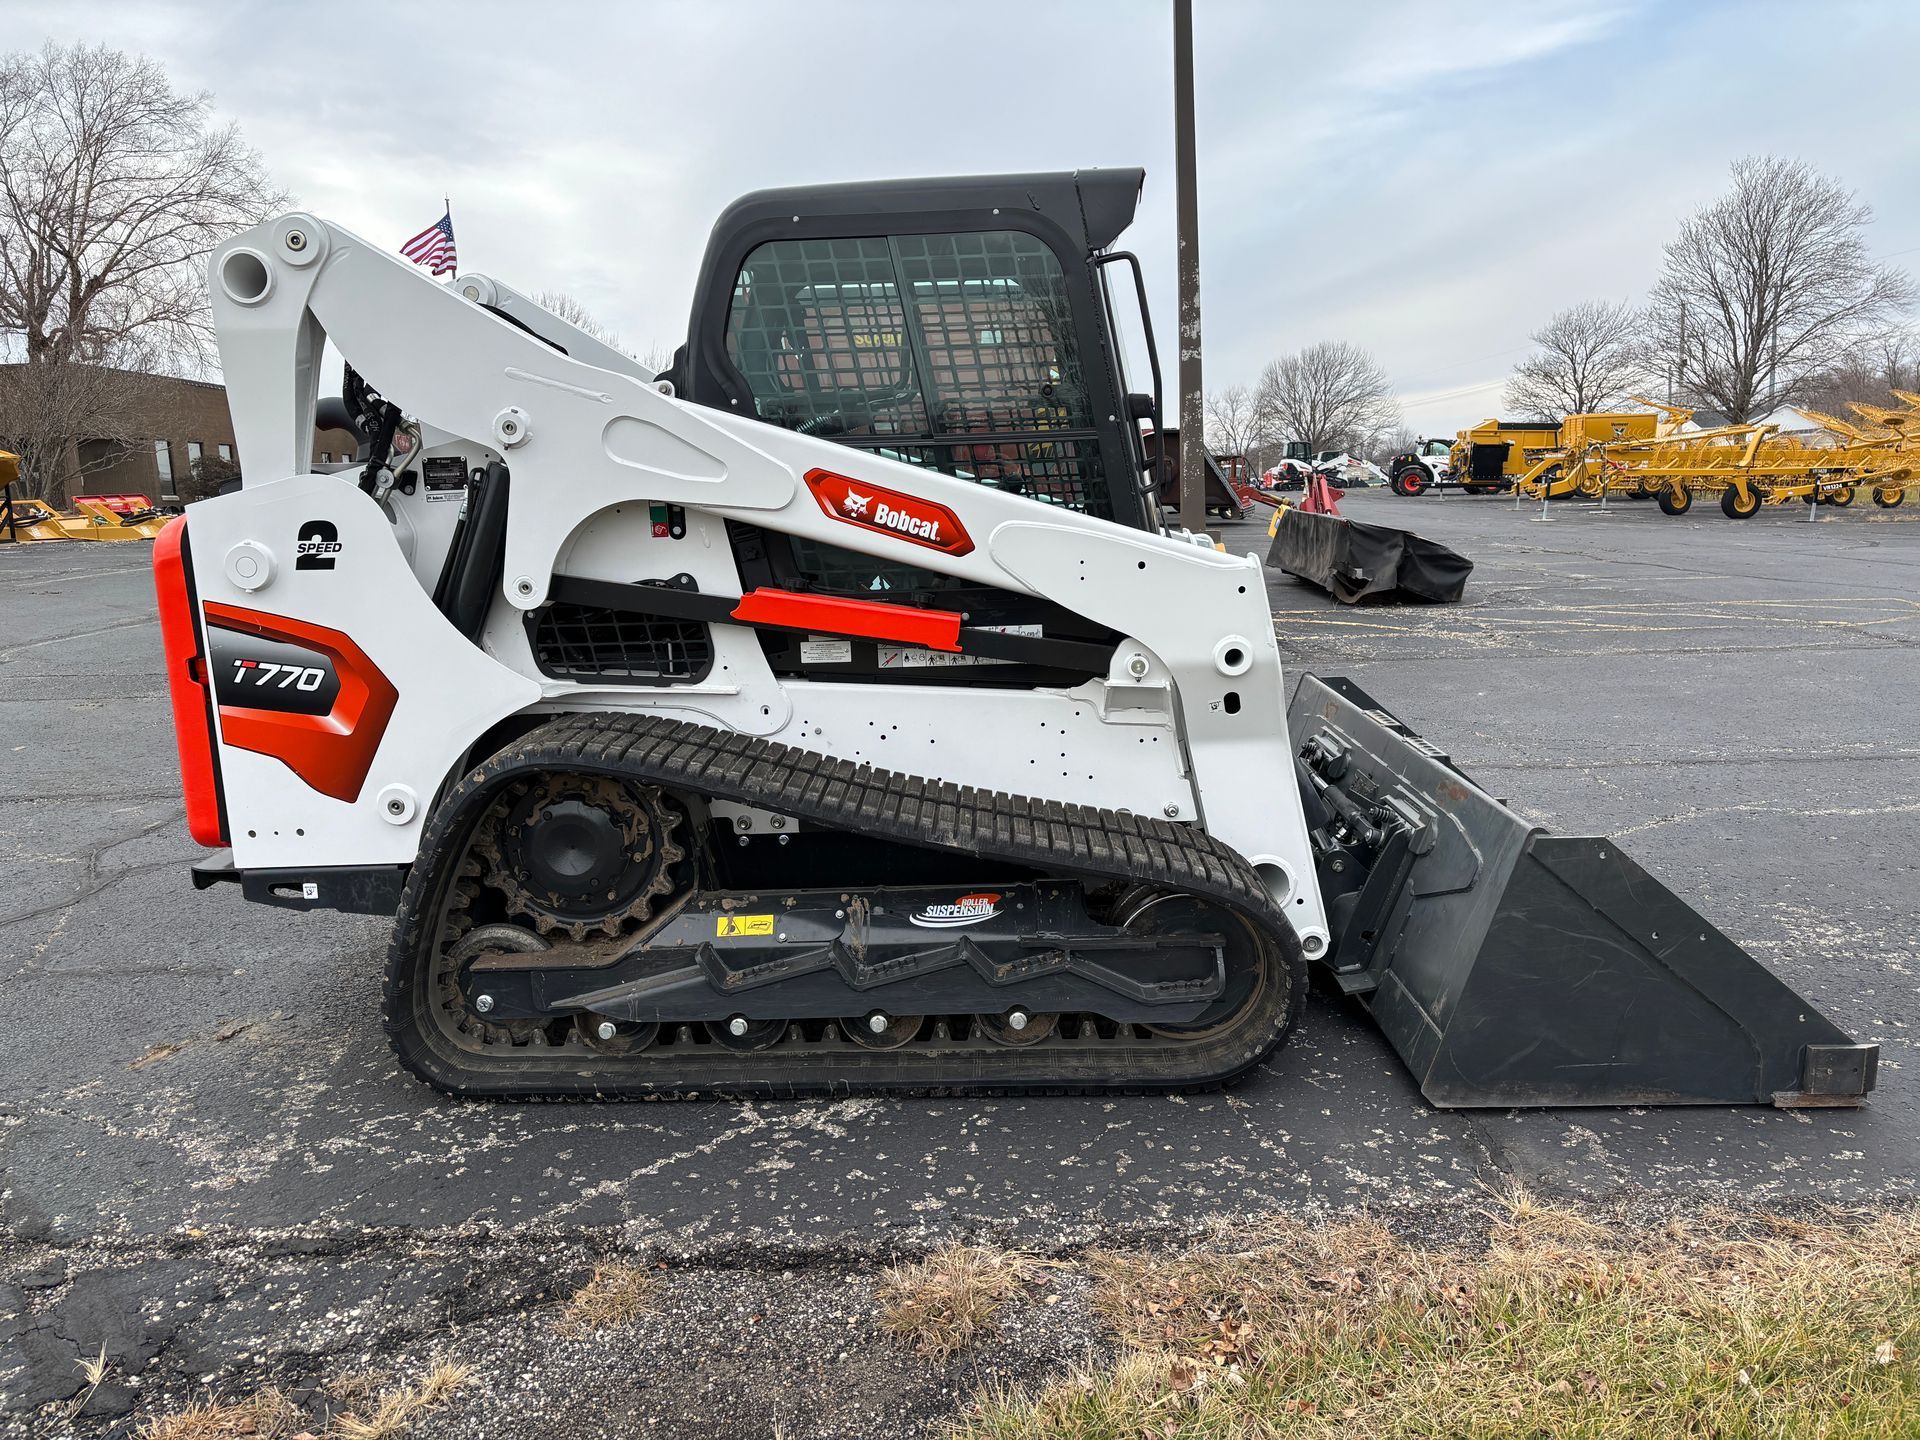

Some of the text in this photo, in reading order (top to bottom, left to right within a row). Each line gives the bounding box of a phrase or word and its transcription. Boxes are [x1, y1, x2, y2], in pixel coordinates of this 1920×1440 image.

[874, 503, 939, 540] Bobcat
[296, 520, 338, 570] 2
[297, 543, 342, 553] SPEED
[233, 660, 325, 691] T770
[926, 904, 994, 916] SUSPENSION
[961, 898, 989, 907] ROLLER
